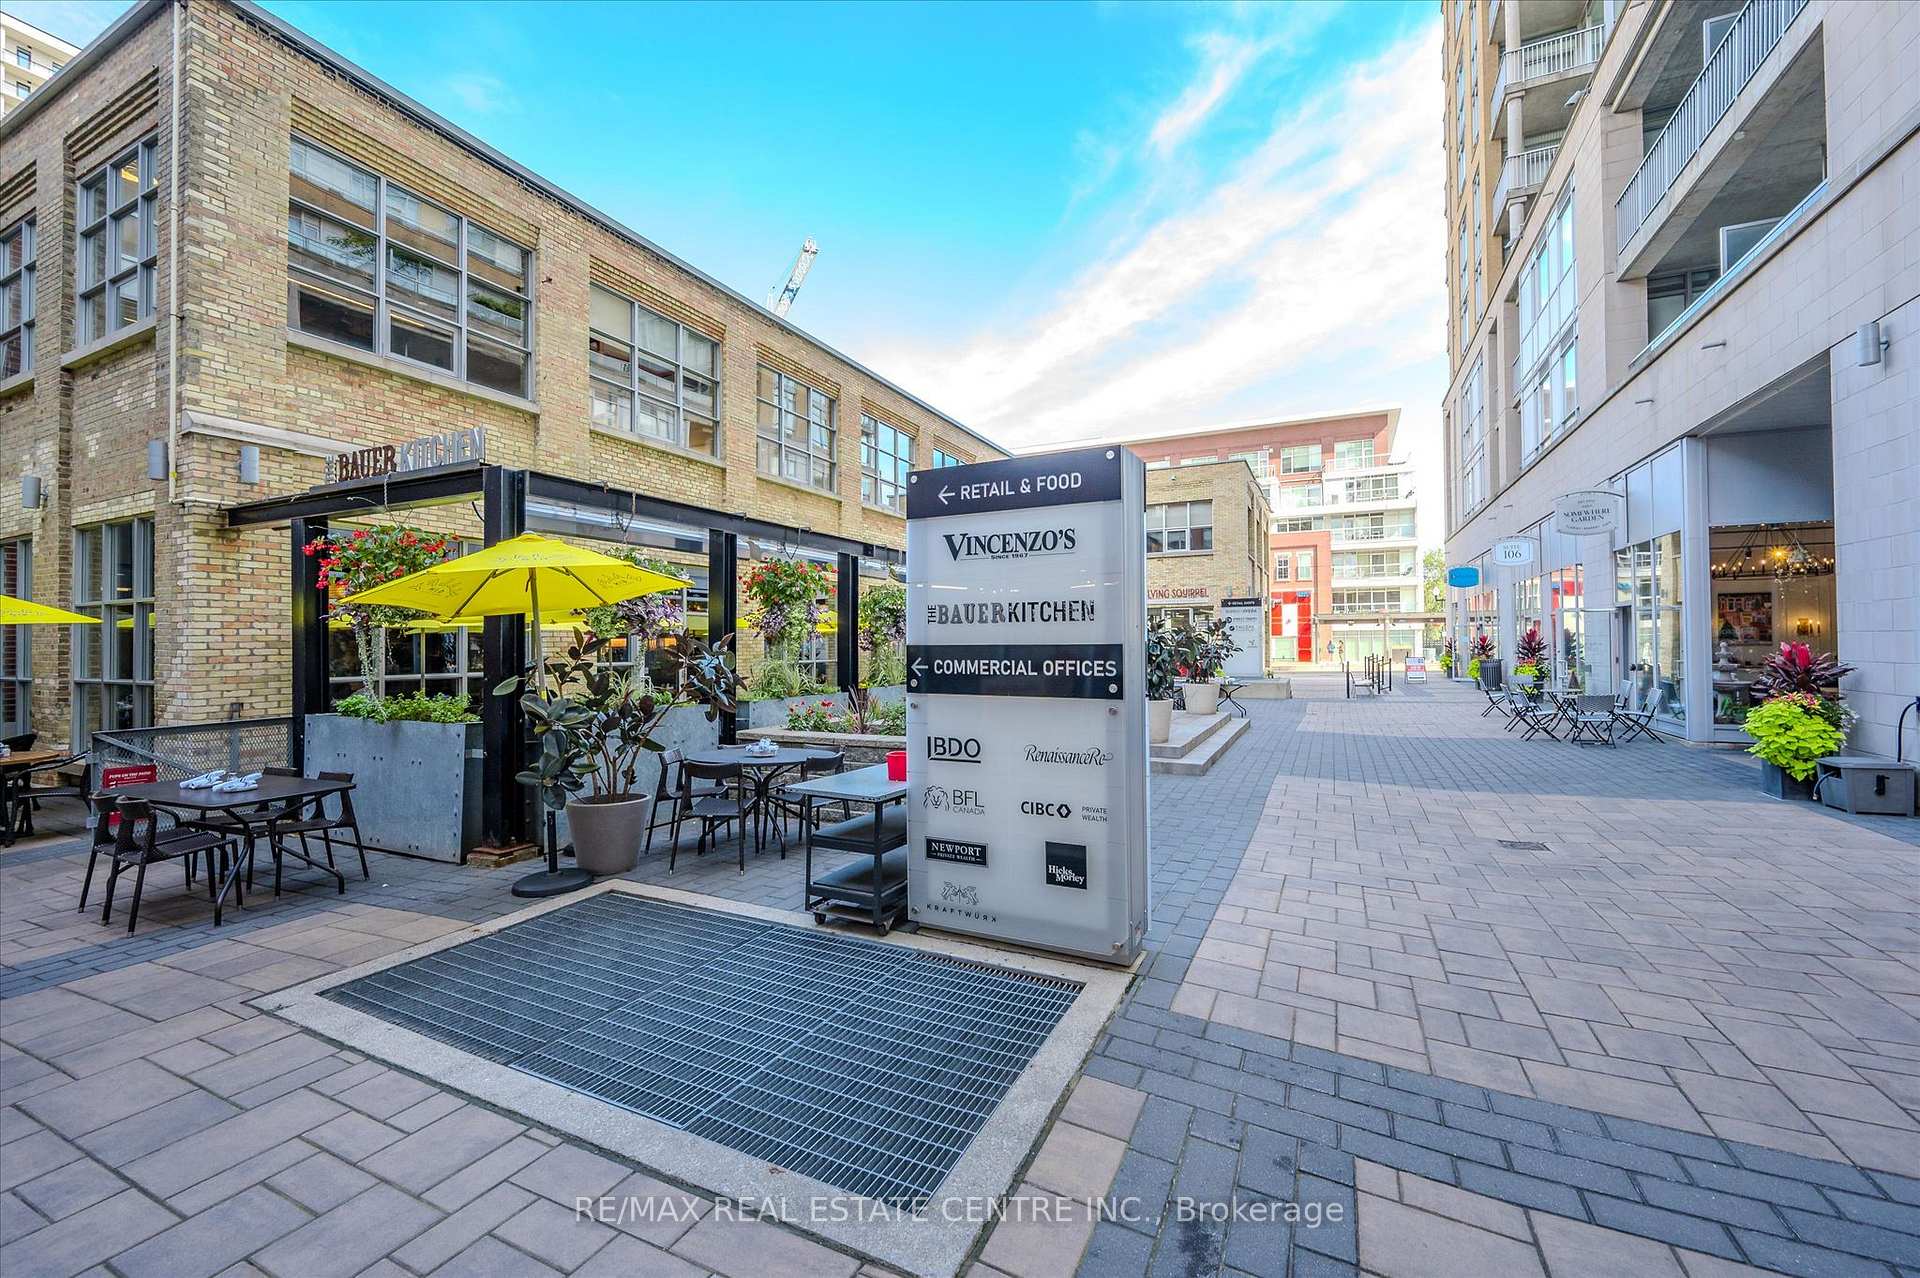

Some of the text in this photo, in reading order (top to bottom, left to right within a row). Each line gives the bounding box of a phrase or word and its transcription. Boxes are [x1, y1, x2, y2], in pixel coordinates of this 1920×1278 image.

[337, 444, 397, 482] BAUER
[399, 427, 485, 472] KITCHEN
[960, 472, 1082, 501] RETAIL & FOOD
[943, 528, 1076, 562] VINCENZO'S
[1504, 550, 1522, 560] 106
[1147, 587, 1209, 600] LVING SQUIRREL
[927, 599, 1095, 625] THE BAUER KITCHEN
[934, 658, 1117, 678] COMMERCIAL OFFICES
[933, 737, 982, 758] BDO
[1023, 743, 1114, 767] RenaissanceRe
[952, 789, 985, 808] BFL
[952, 805, 985, 816] CANADA
[1020, 800, 1056, 817] CIBC
[1081, 806, 1108, 815] PRIVATE
[1081, 814, 1108, 823] WEALTH
[931, 841, 982, 857] NEWPORT
[1048, 864, 1073, 875] Hicks
[1056, 873, 1085, 885] Morley
